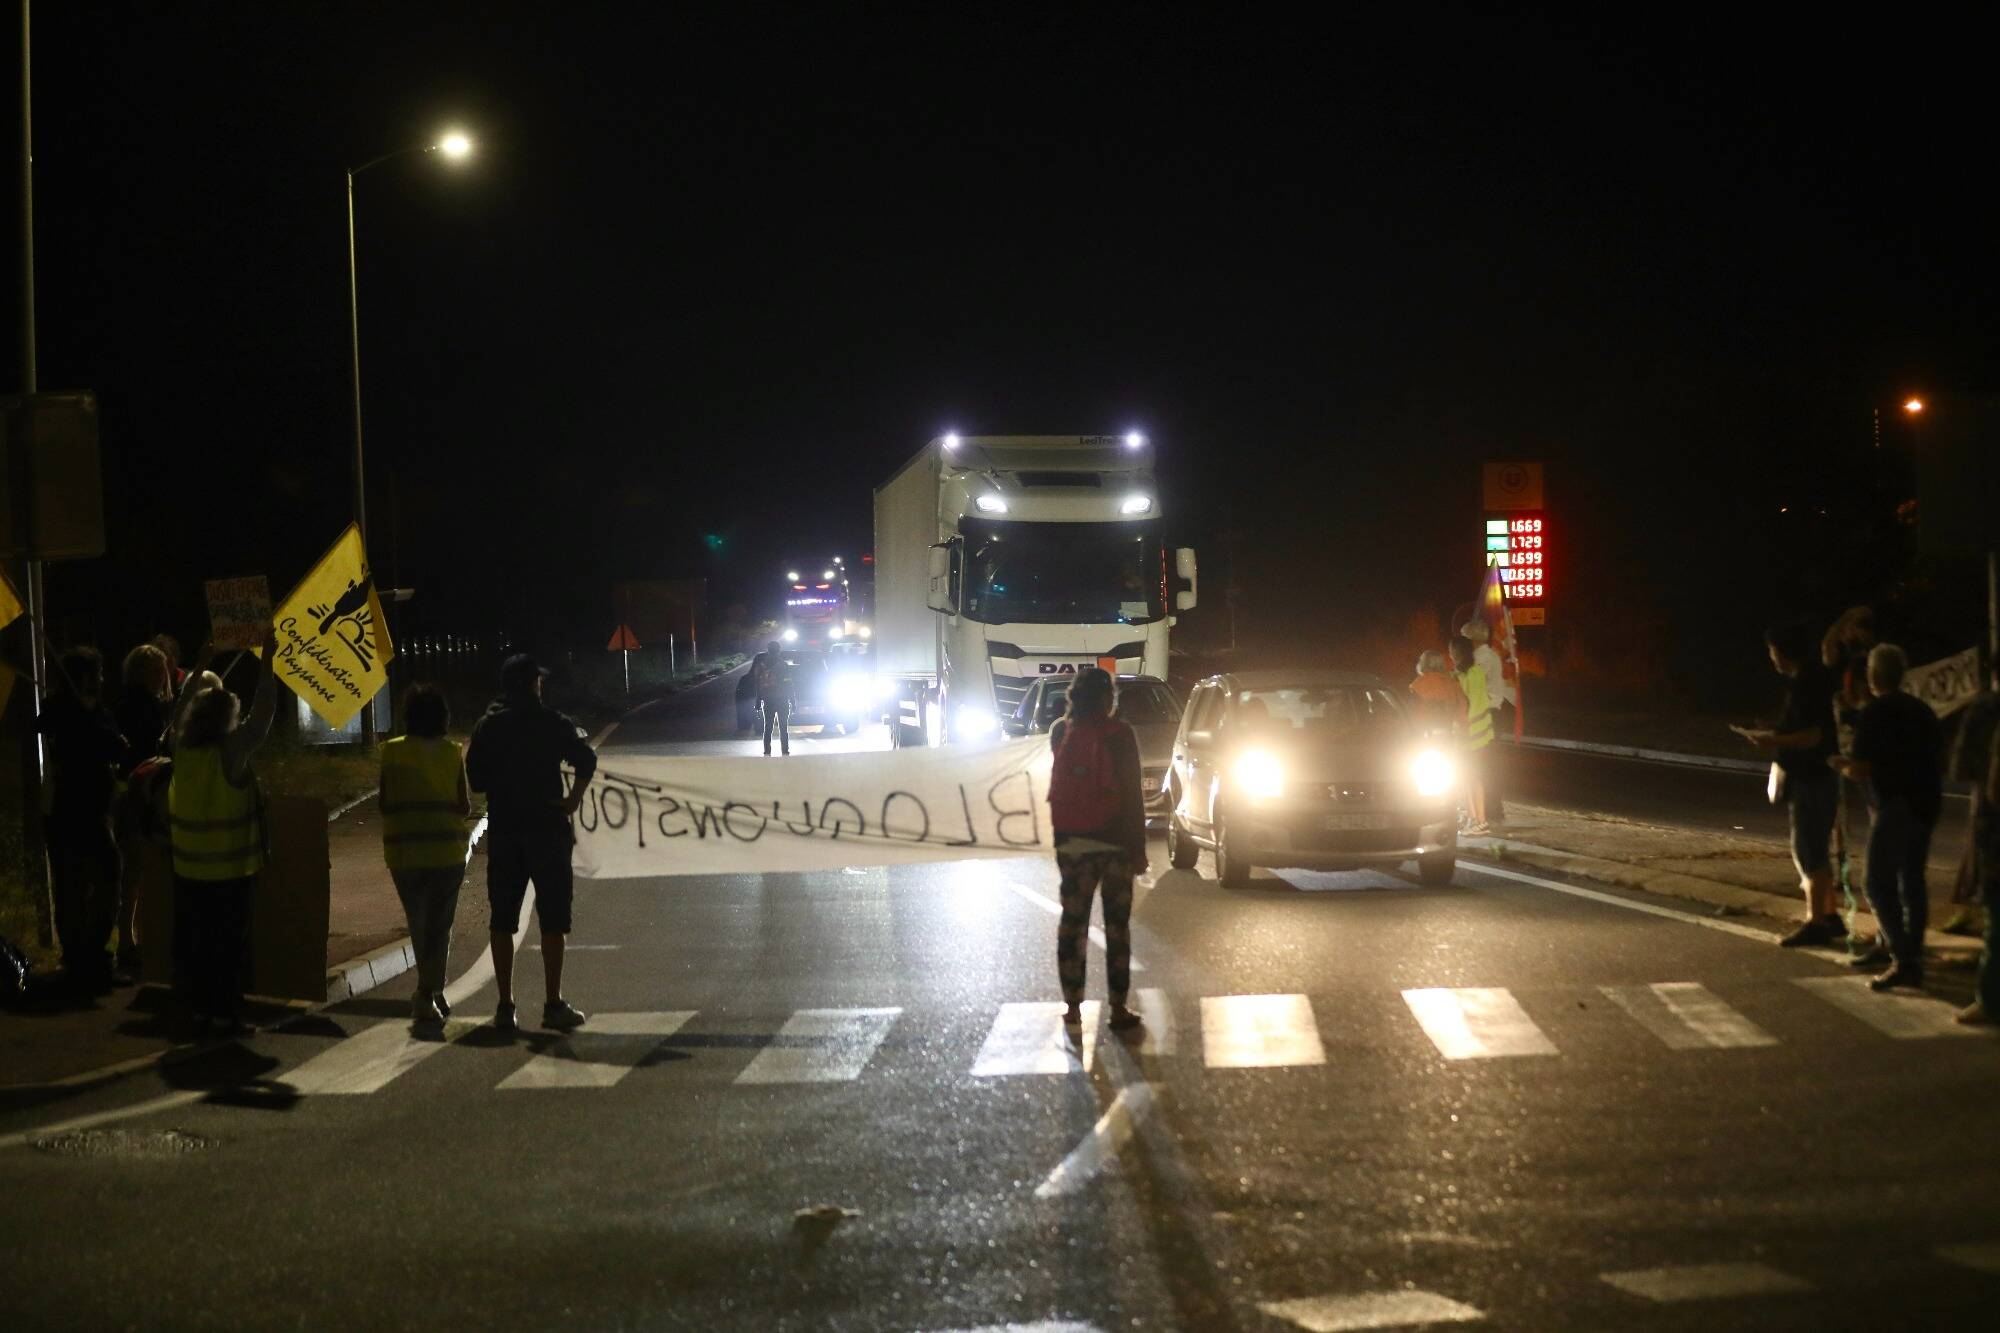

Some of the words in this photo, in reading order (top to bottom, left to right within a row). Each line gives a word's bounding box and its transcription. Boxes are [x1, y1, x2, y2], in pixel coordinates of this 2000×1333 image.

[1511, 519, 1542, 532] 1.669
[1511, 536, 1542, 548] 1.729
[1511, 552, 1542, 564] 1.699
[1508, 568, 1543, 581] 0.699
[1512, 584, 1543, 597] 1.559
[280, 617, 361, 698] Confédération
[279, 643, 336, 702] Paysanne
